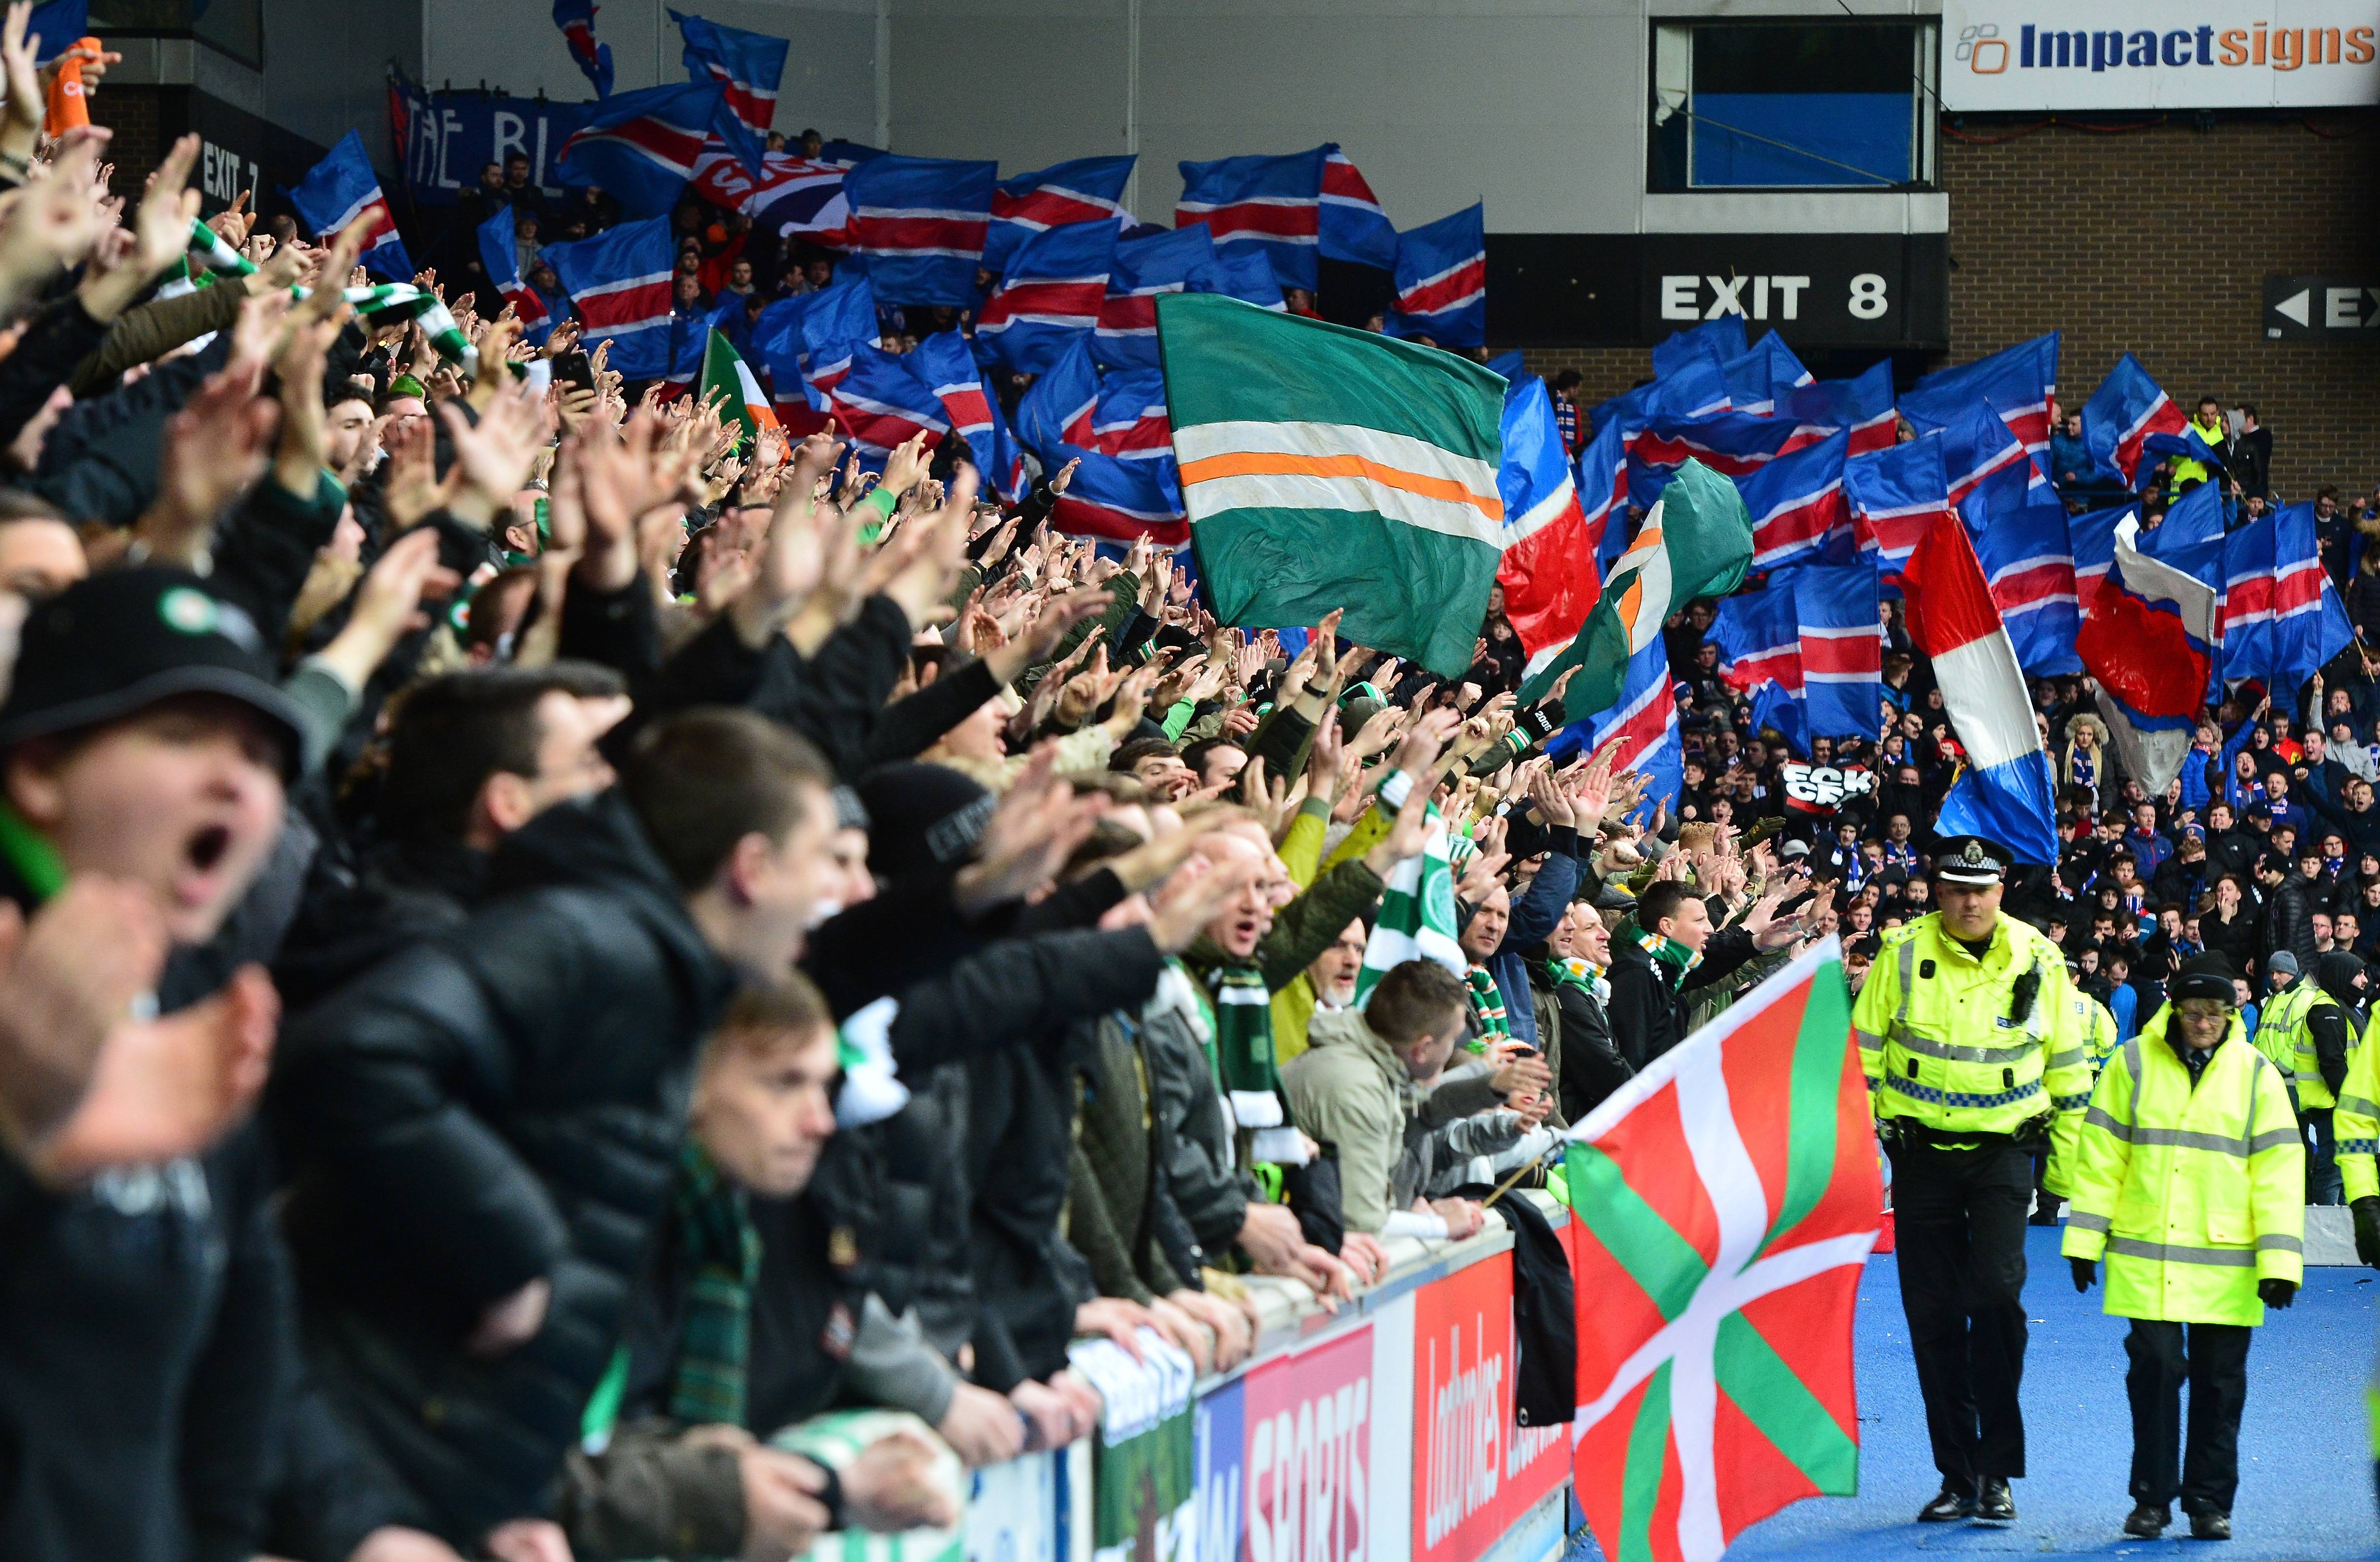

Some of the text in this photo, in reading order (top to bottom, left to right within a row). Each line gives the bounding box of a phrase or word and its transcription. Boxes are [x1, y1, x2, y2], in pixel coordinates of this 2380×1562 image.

[408, 96, 564, 198] THE BL
[203, 141, 259, 213] EXIT 7
[1661, 273, 1888, 320] EXIT 8
[1535, 711, 1552, 731] 2006
